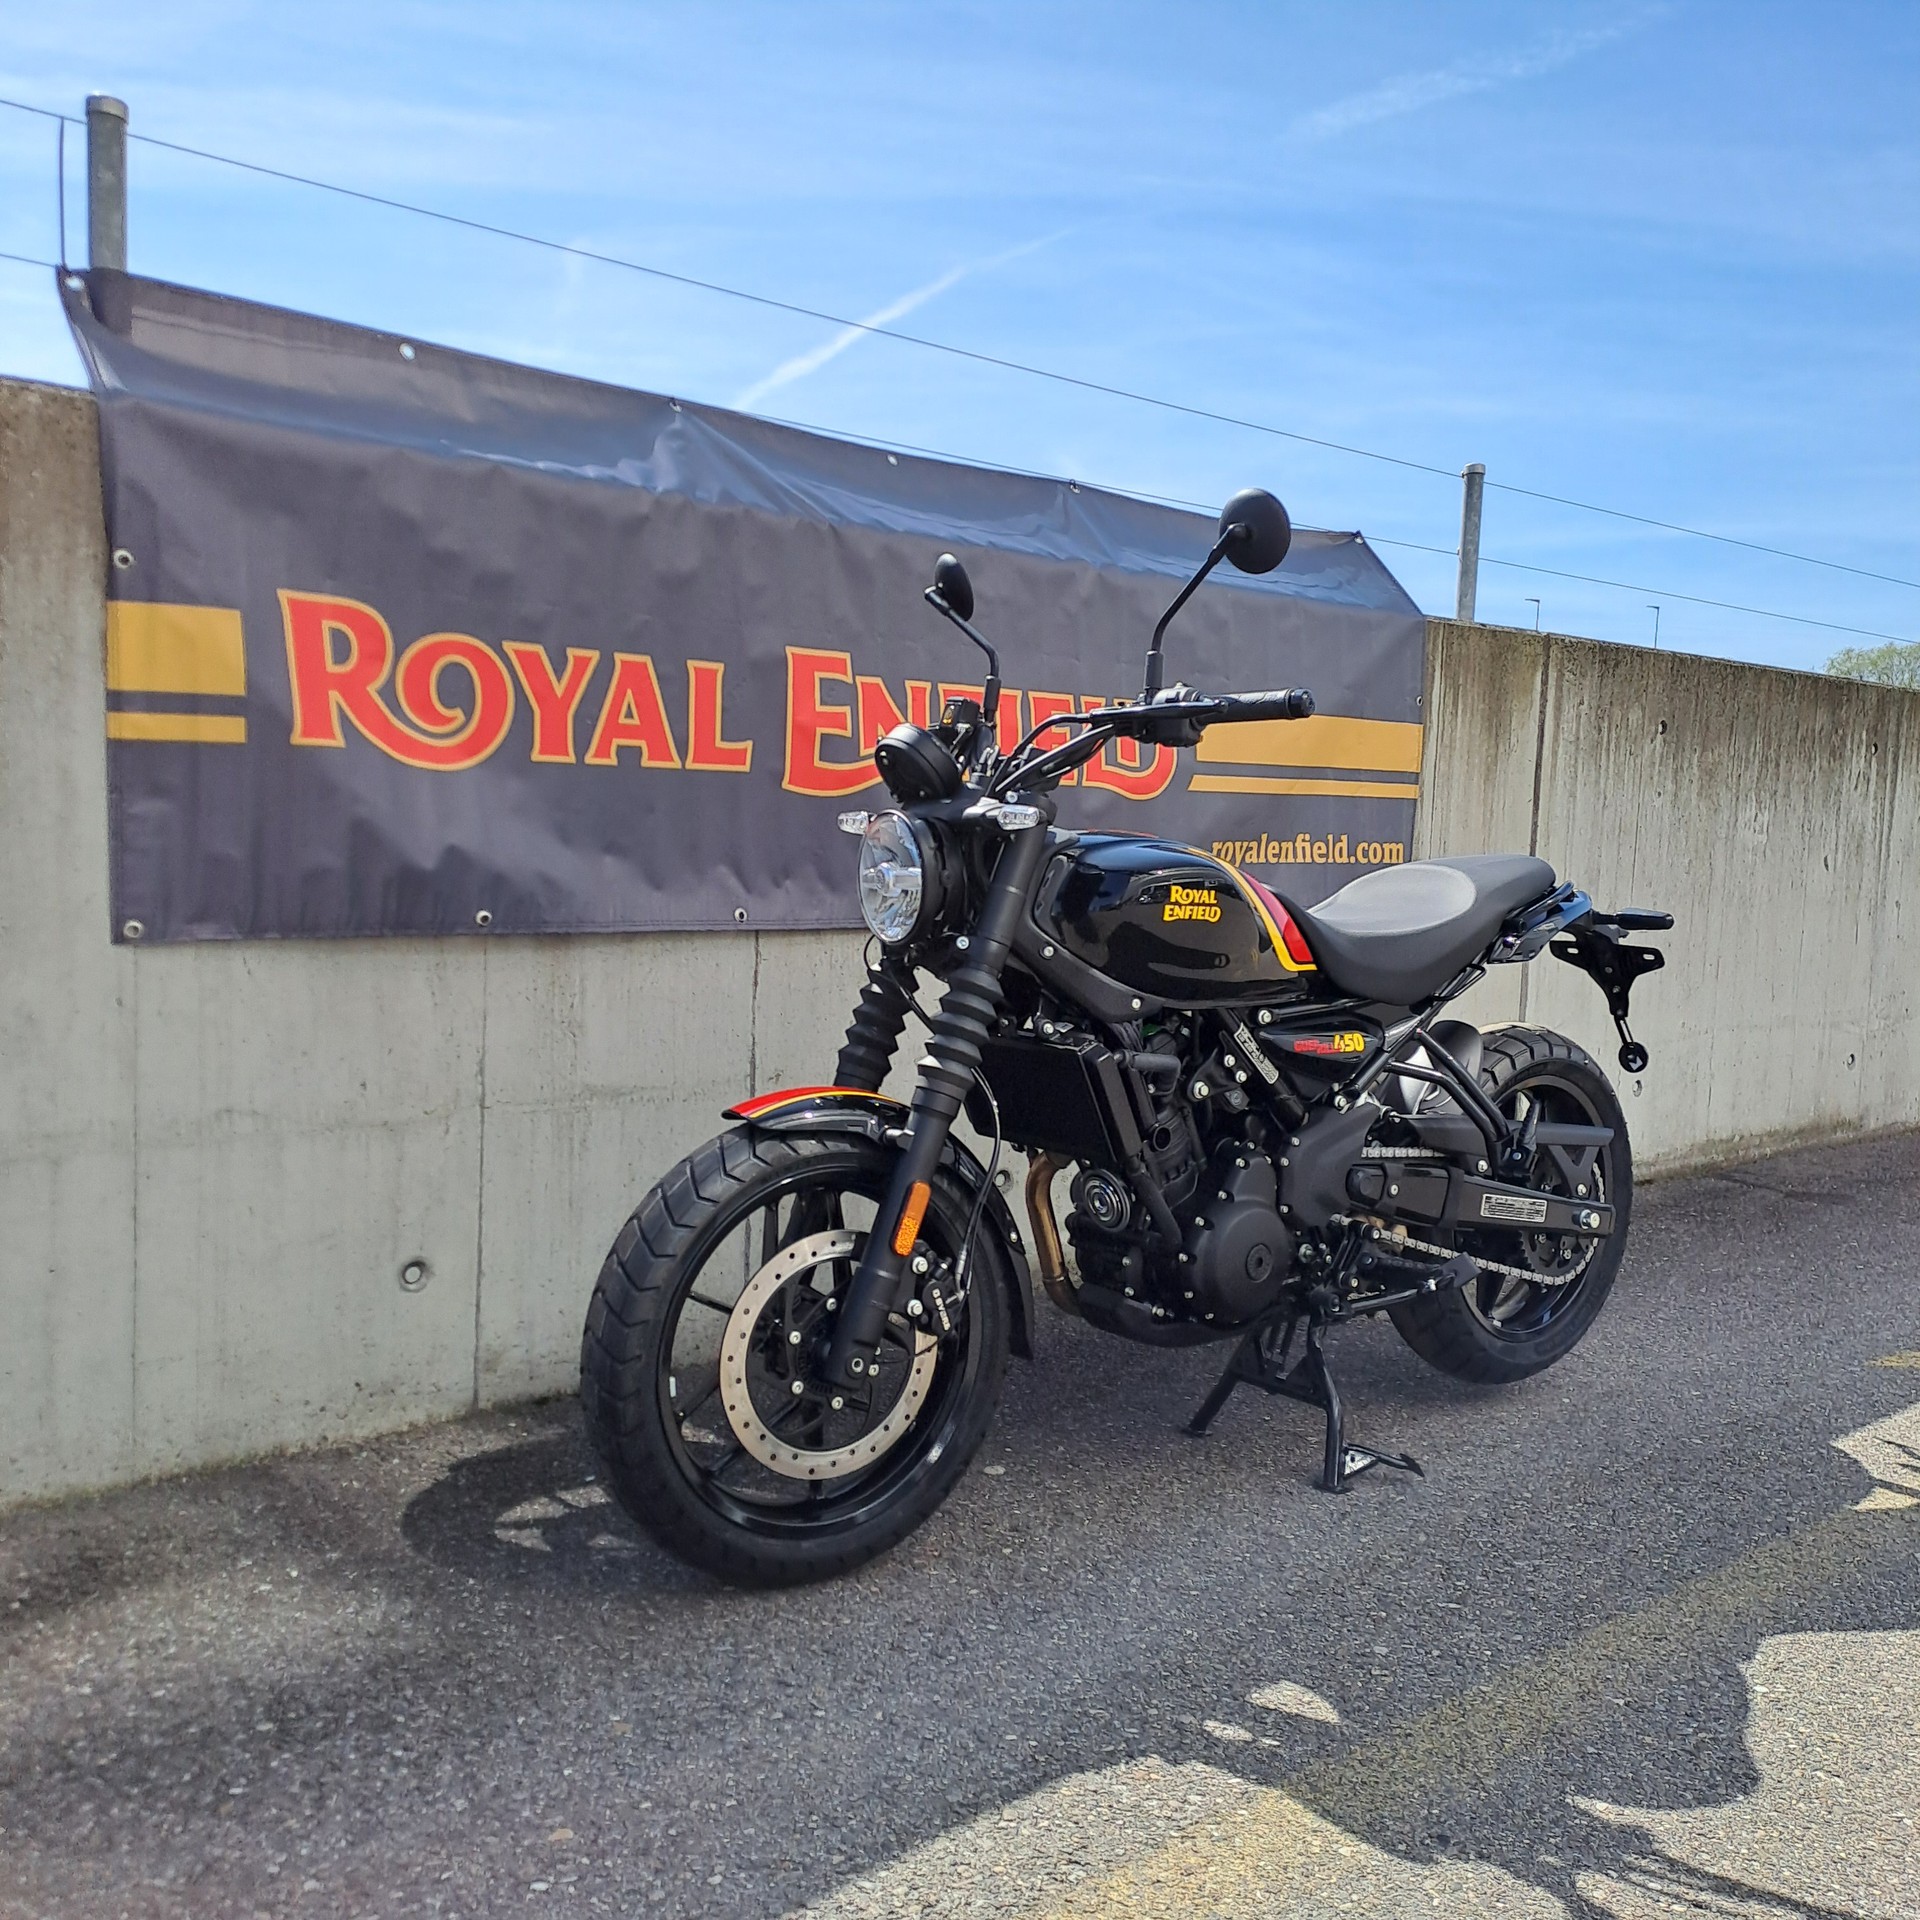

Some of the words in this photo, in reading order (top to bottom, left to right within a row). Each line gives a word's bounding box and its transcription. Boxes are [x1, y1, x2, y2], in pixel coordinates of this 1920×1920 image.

[277, 588, 753, 772] ROYAL
[781, 645, 1178, 801] ENIELD
[1211, 832, 1405, 868] royalenfield.com
[1169, 885, 1218, 905] ROYAL
[1162, 904, 1222, 923] ENFIELD
[1334, 1032, 1365, 1053] 450
